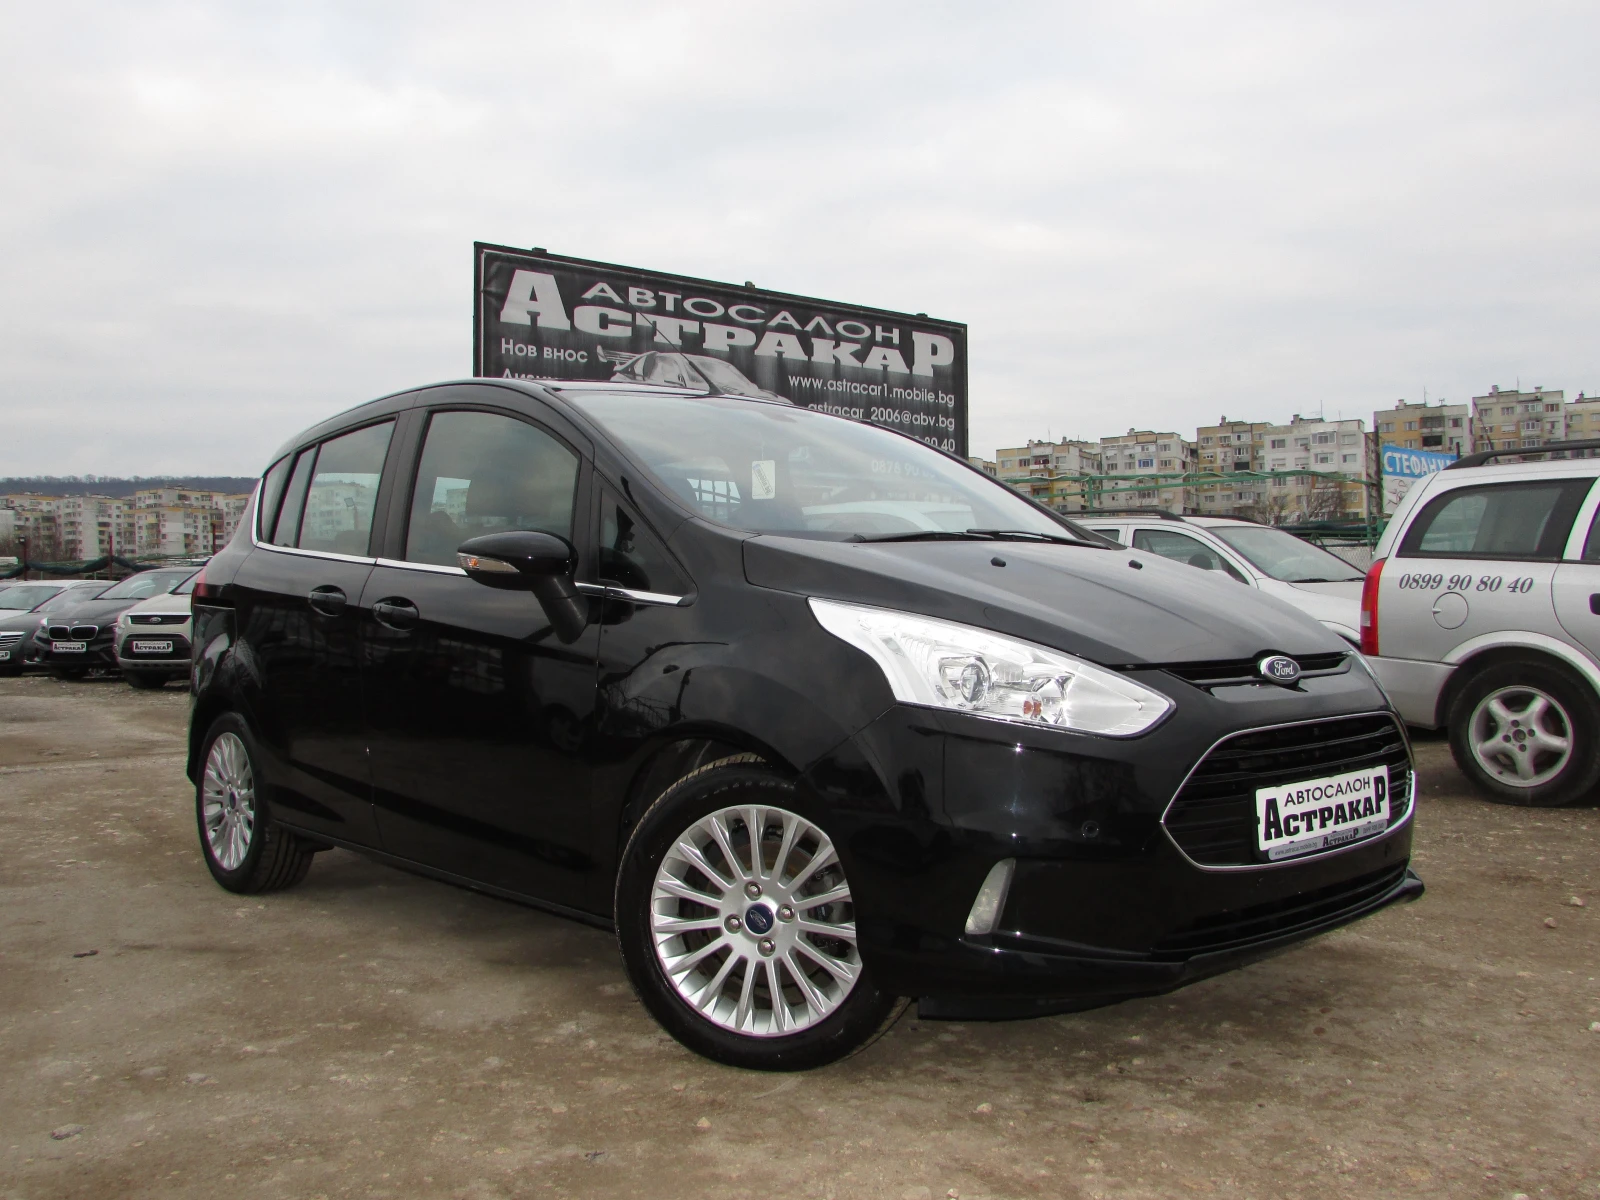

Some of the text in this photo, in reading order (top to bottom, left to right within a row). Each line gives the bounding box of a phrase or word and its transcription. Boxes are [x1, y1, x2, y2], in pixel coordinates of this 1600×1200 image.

[500, 269, 955, 377] АСТРАКАР
[581, 282, 899, 345] АВТОСАЛОН
[788, 375, 955, 408] www.astracar1.mobile.bg
[941, 438, 956, 452] 40
[1398, 573, 1533, 594] 0899 90 80 40
[1273, 660, 1295, 676] Ford
[1284, 776, 1371, 807] АВТОСАЛОН
[1264, 775, 1386, 841] АСТРАКАР
